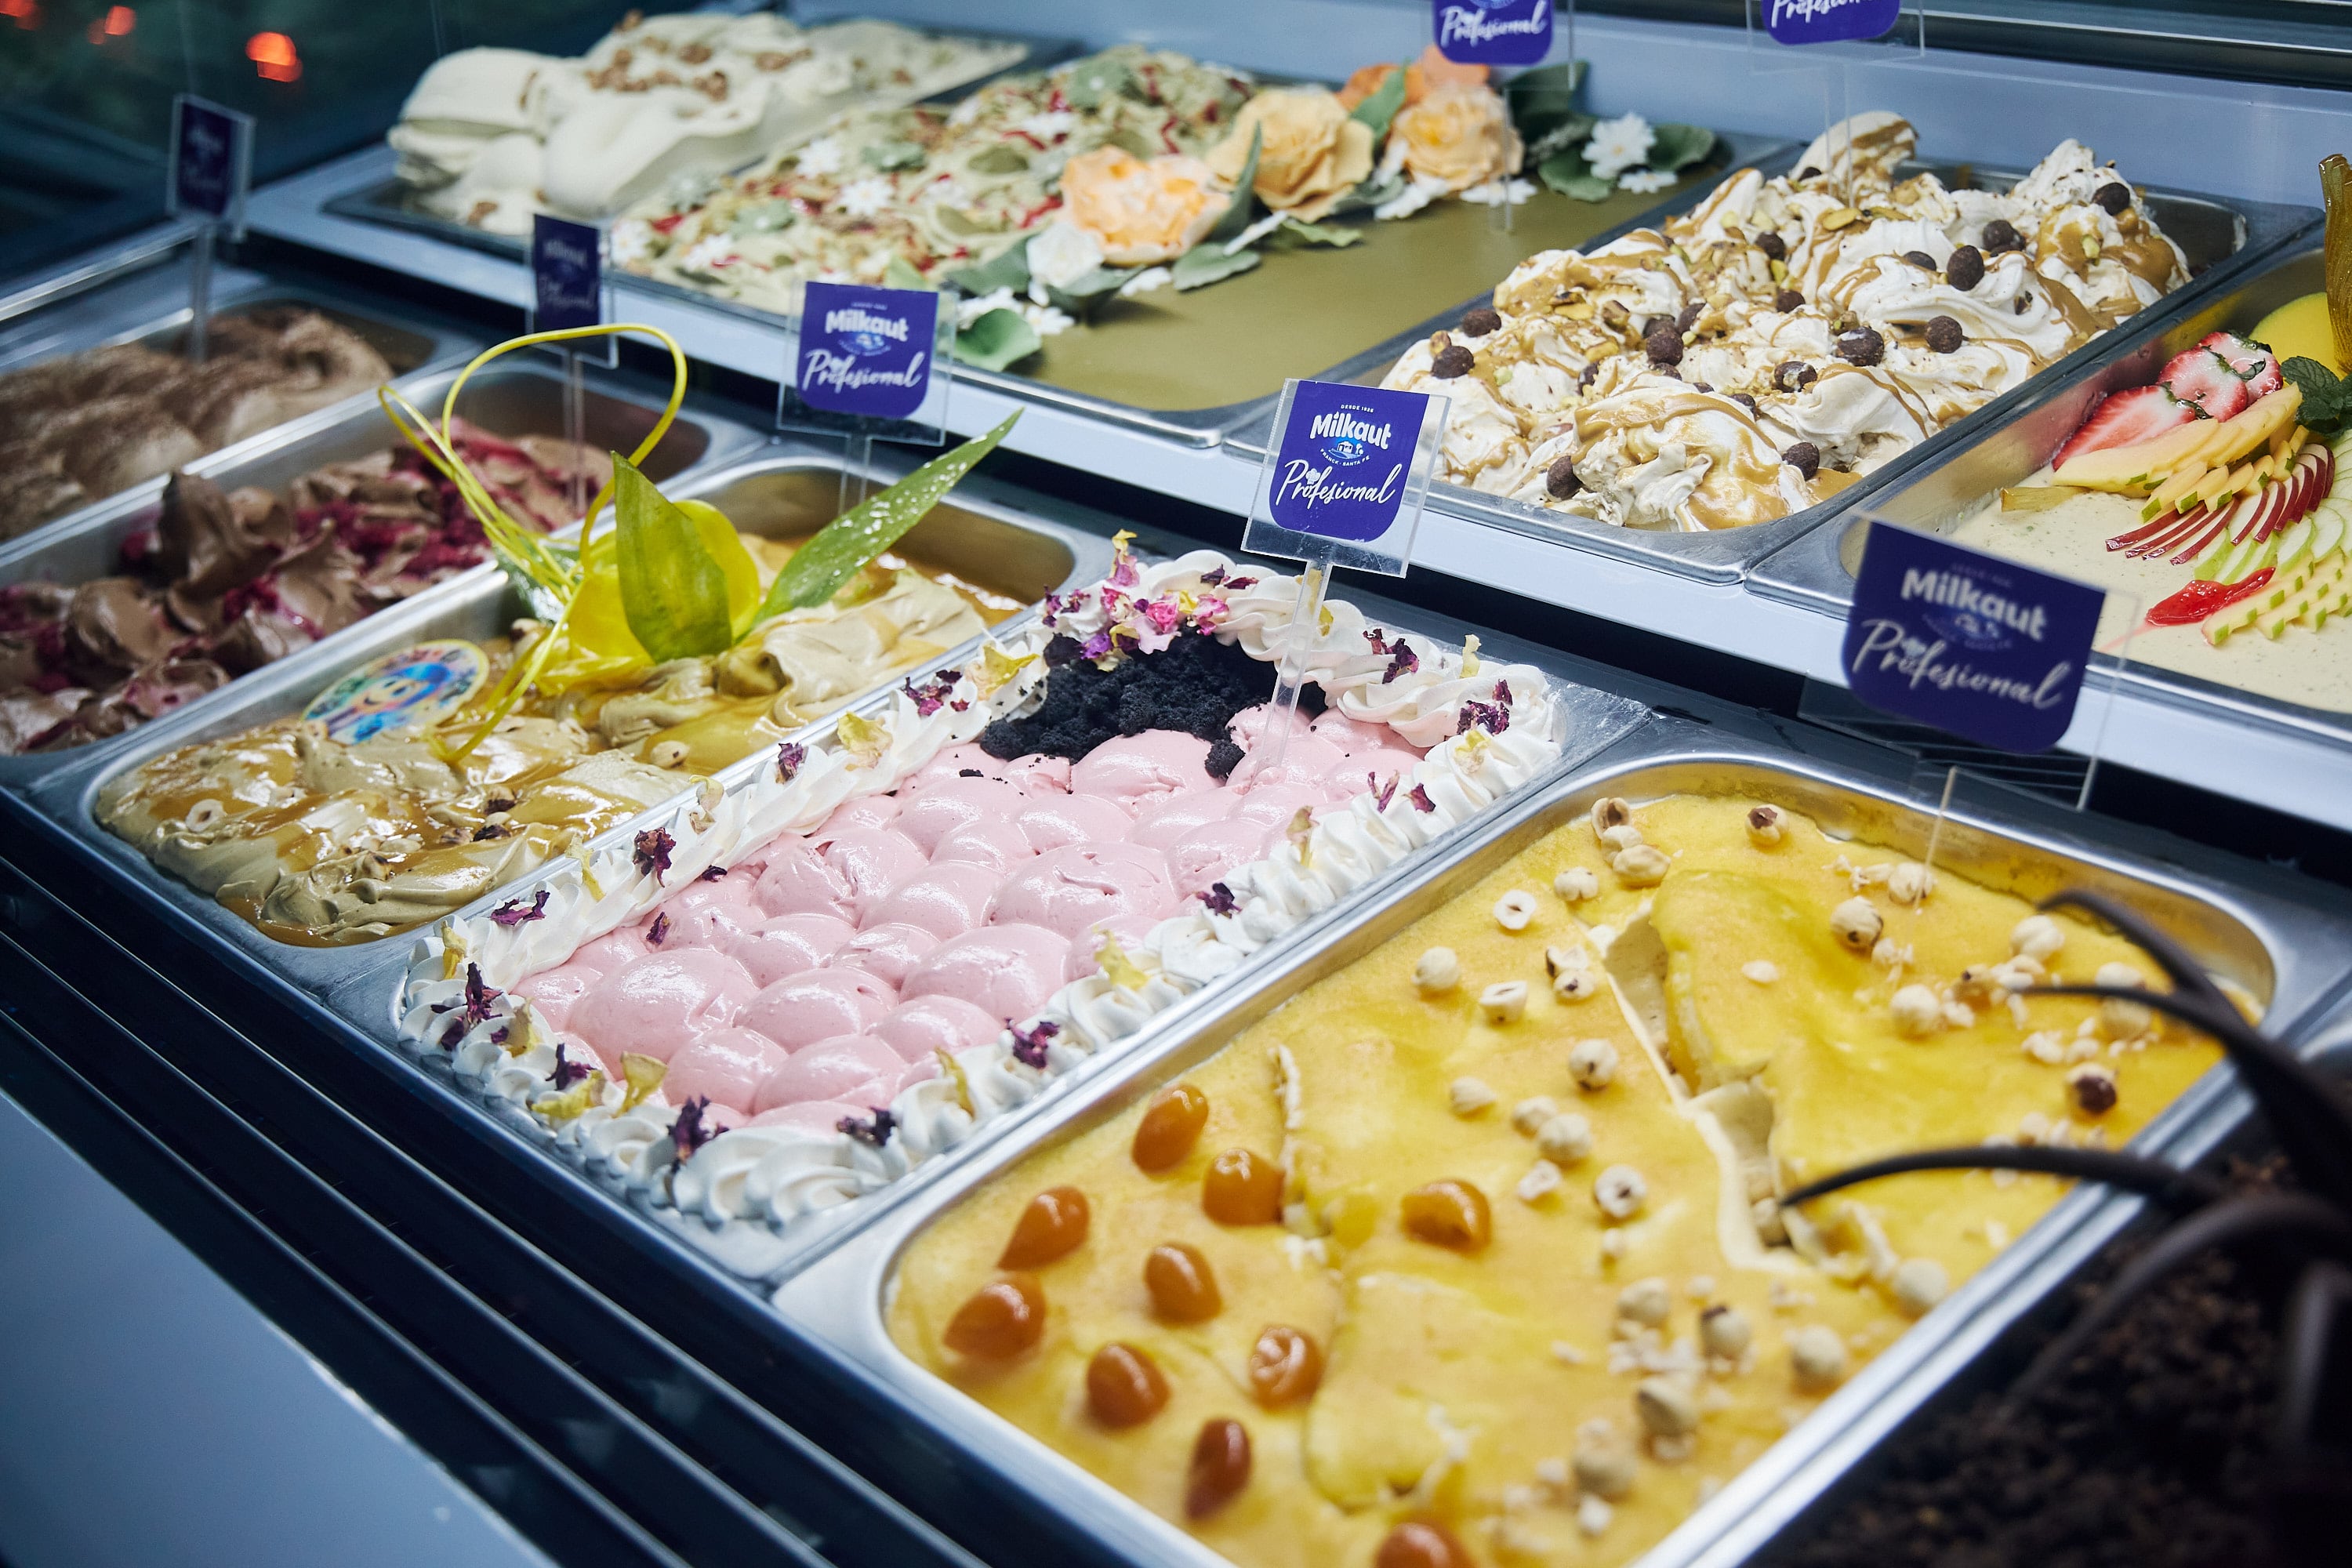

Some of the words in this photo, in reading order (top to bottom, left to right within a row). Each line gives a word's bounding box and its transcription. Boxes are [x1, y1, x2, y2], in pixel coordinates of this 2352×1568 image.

[825, 309, 909, 342] Milkaut
[801, 348, 925, 394] Profesional
[1309, 412, 1392, 450] Milkaut
[1319, 448, 1339, 465] FRANCK
[1276, 459, 1403, 510] Profesional
[1900, 568, 2047, 641] Milkaut
[1852, 619, 2072, 710] Profesional
